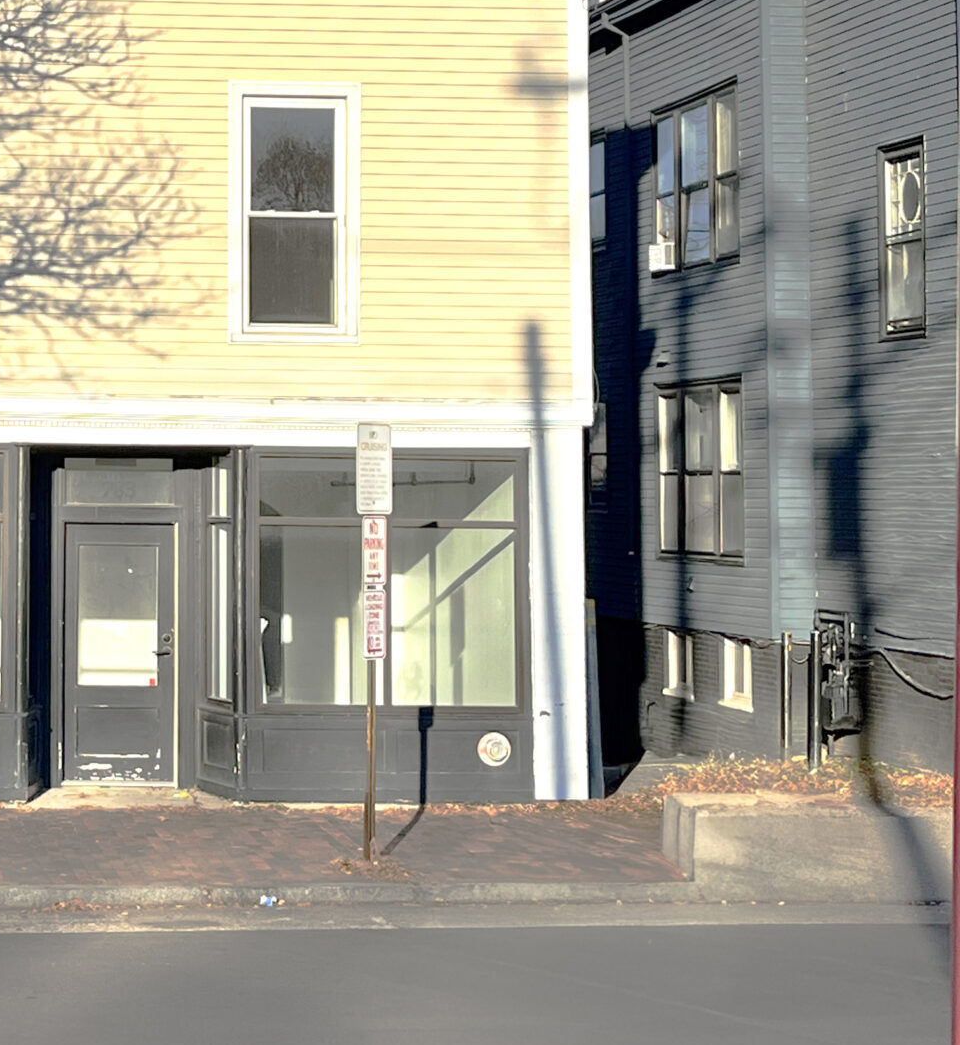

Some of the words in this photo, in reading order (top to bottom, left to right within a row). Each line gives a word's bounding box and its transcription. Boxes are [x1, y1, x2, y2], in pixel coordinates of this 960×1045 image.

[369, 522, 379, 535] NO
[363, 538, 385, 550] PARKING
[369, 552, 379, 560] ANY
